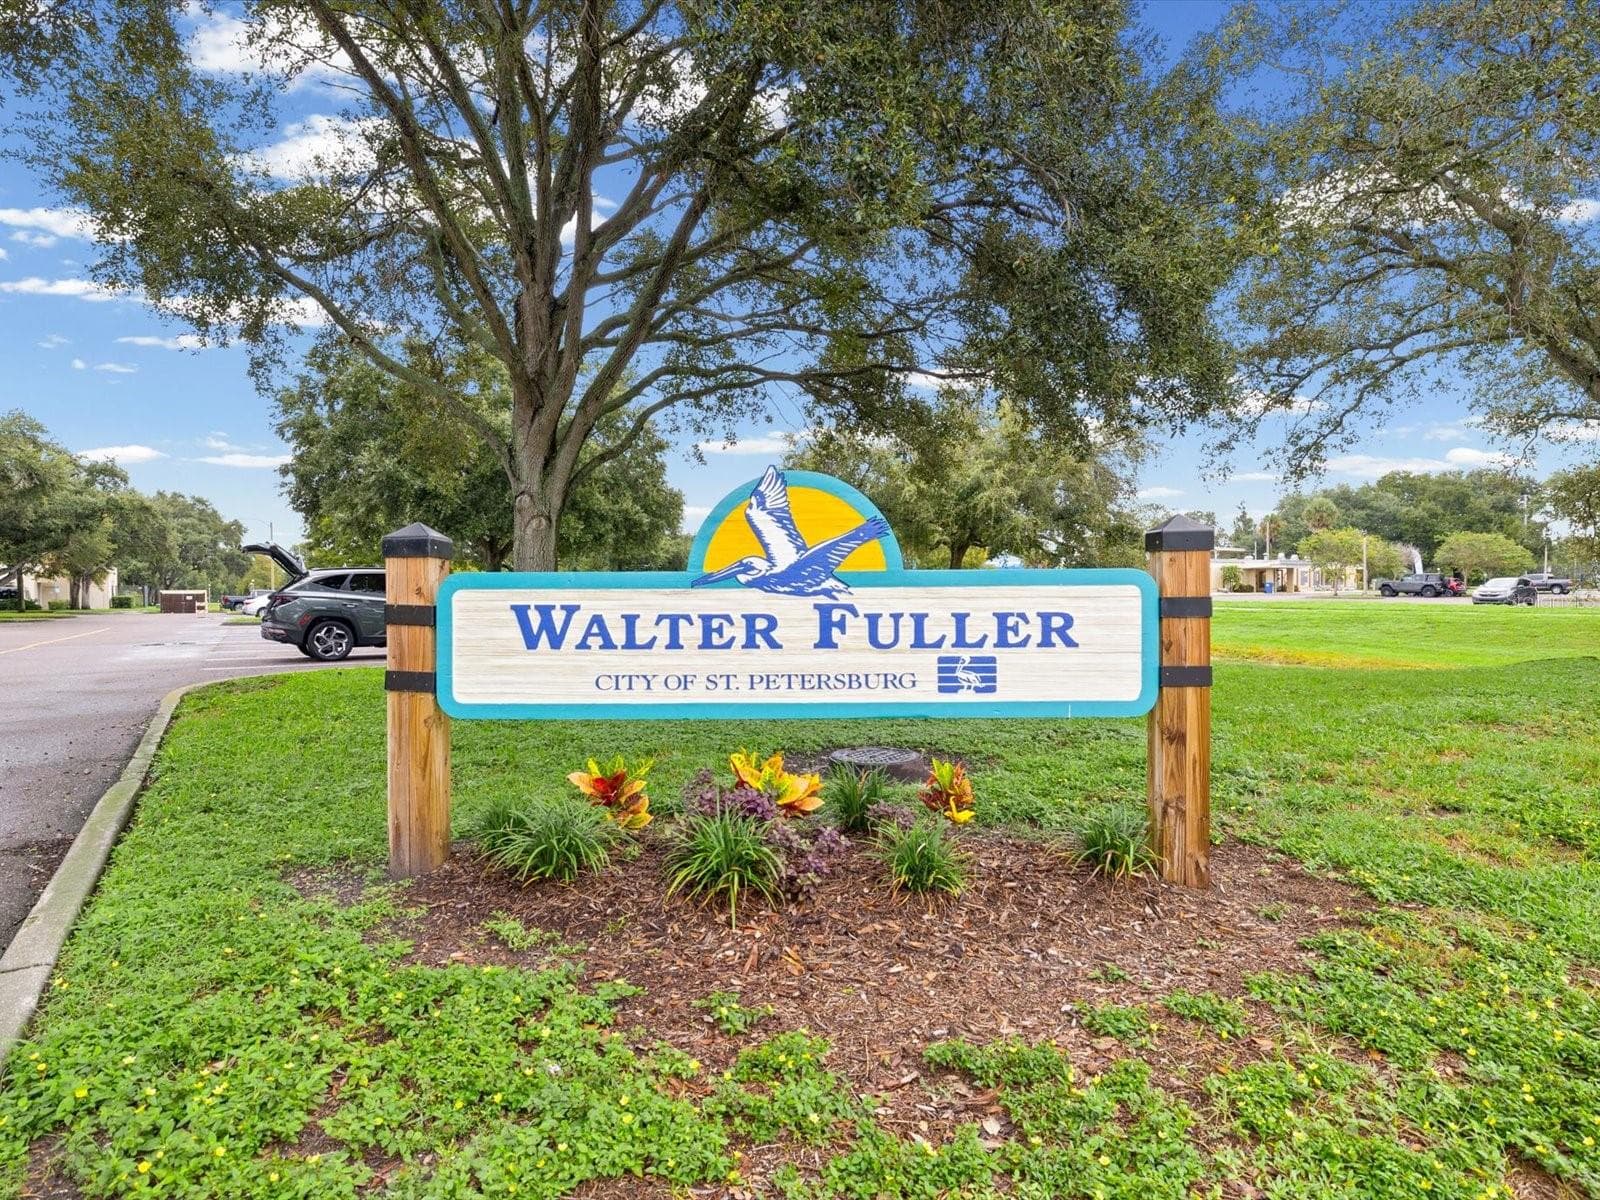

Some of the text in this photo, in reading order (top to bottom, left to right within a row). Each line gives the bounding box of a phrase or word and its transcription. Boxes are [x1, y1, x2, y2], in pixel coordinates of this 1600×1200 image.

[510, 603, 1079, 650] WALTER FULLER
[595, 672, 917, 691] CITY OF ST. PETERSBURG
